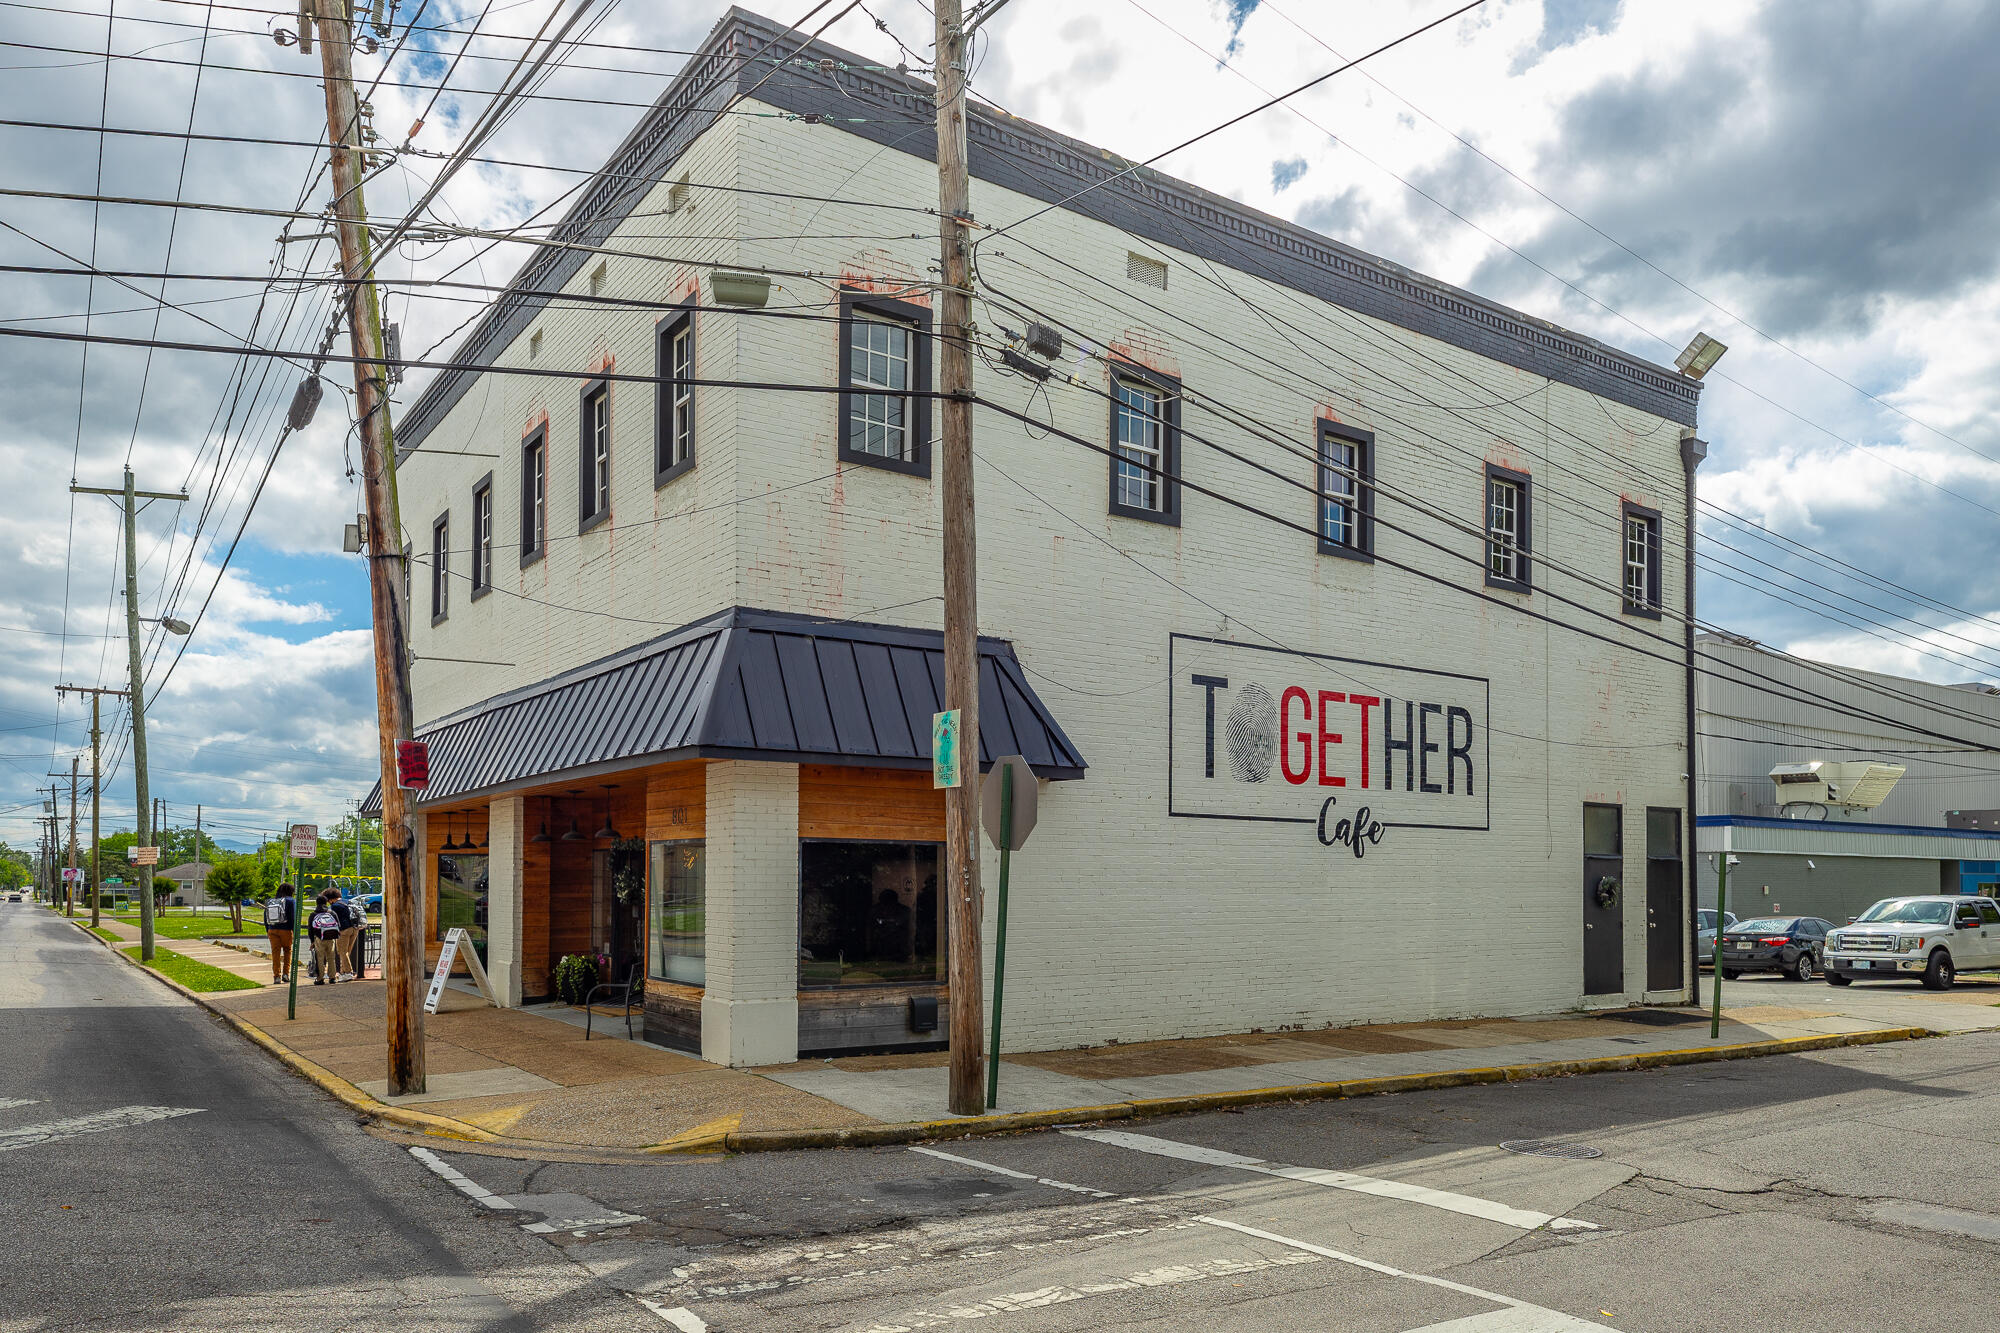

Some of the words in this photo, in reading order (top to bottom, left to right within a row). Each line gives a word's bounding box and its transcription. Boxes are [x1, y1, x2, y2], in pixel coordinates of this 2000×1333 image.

[672, 807, 687, 825] 801
[292, 832, 316, 840] PARKING
[1317, 796, 1385, 858] Cafe
